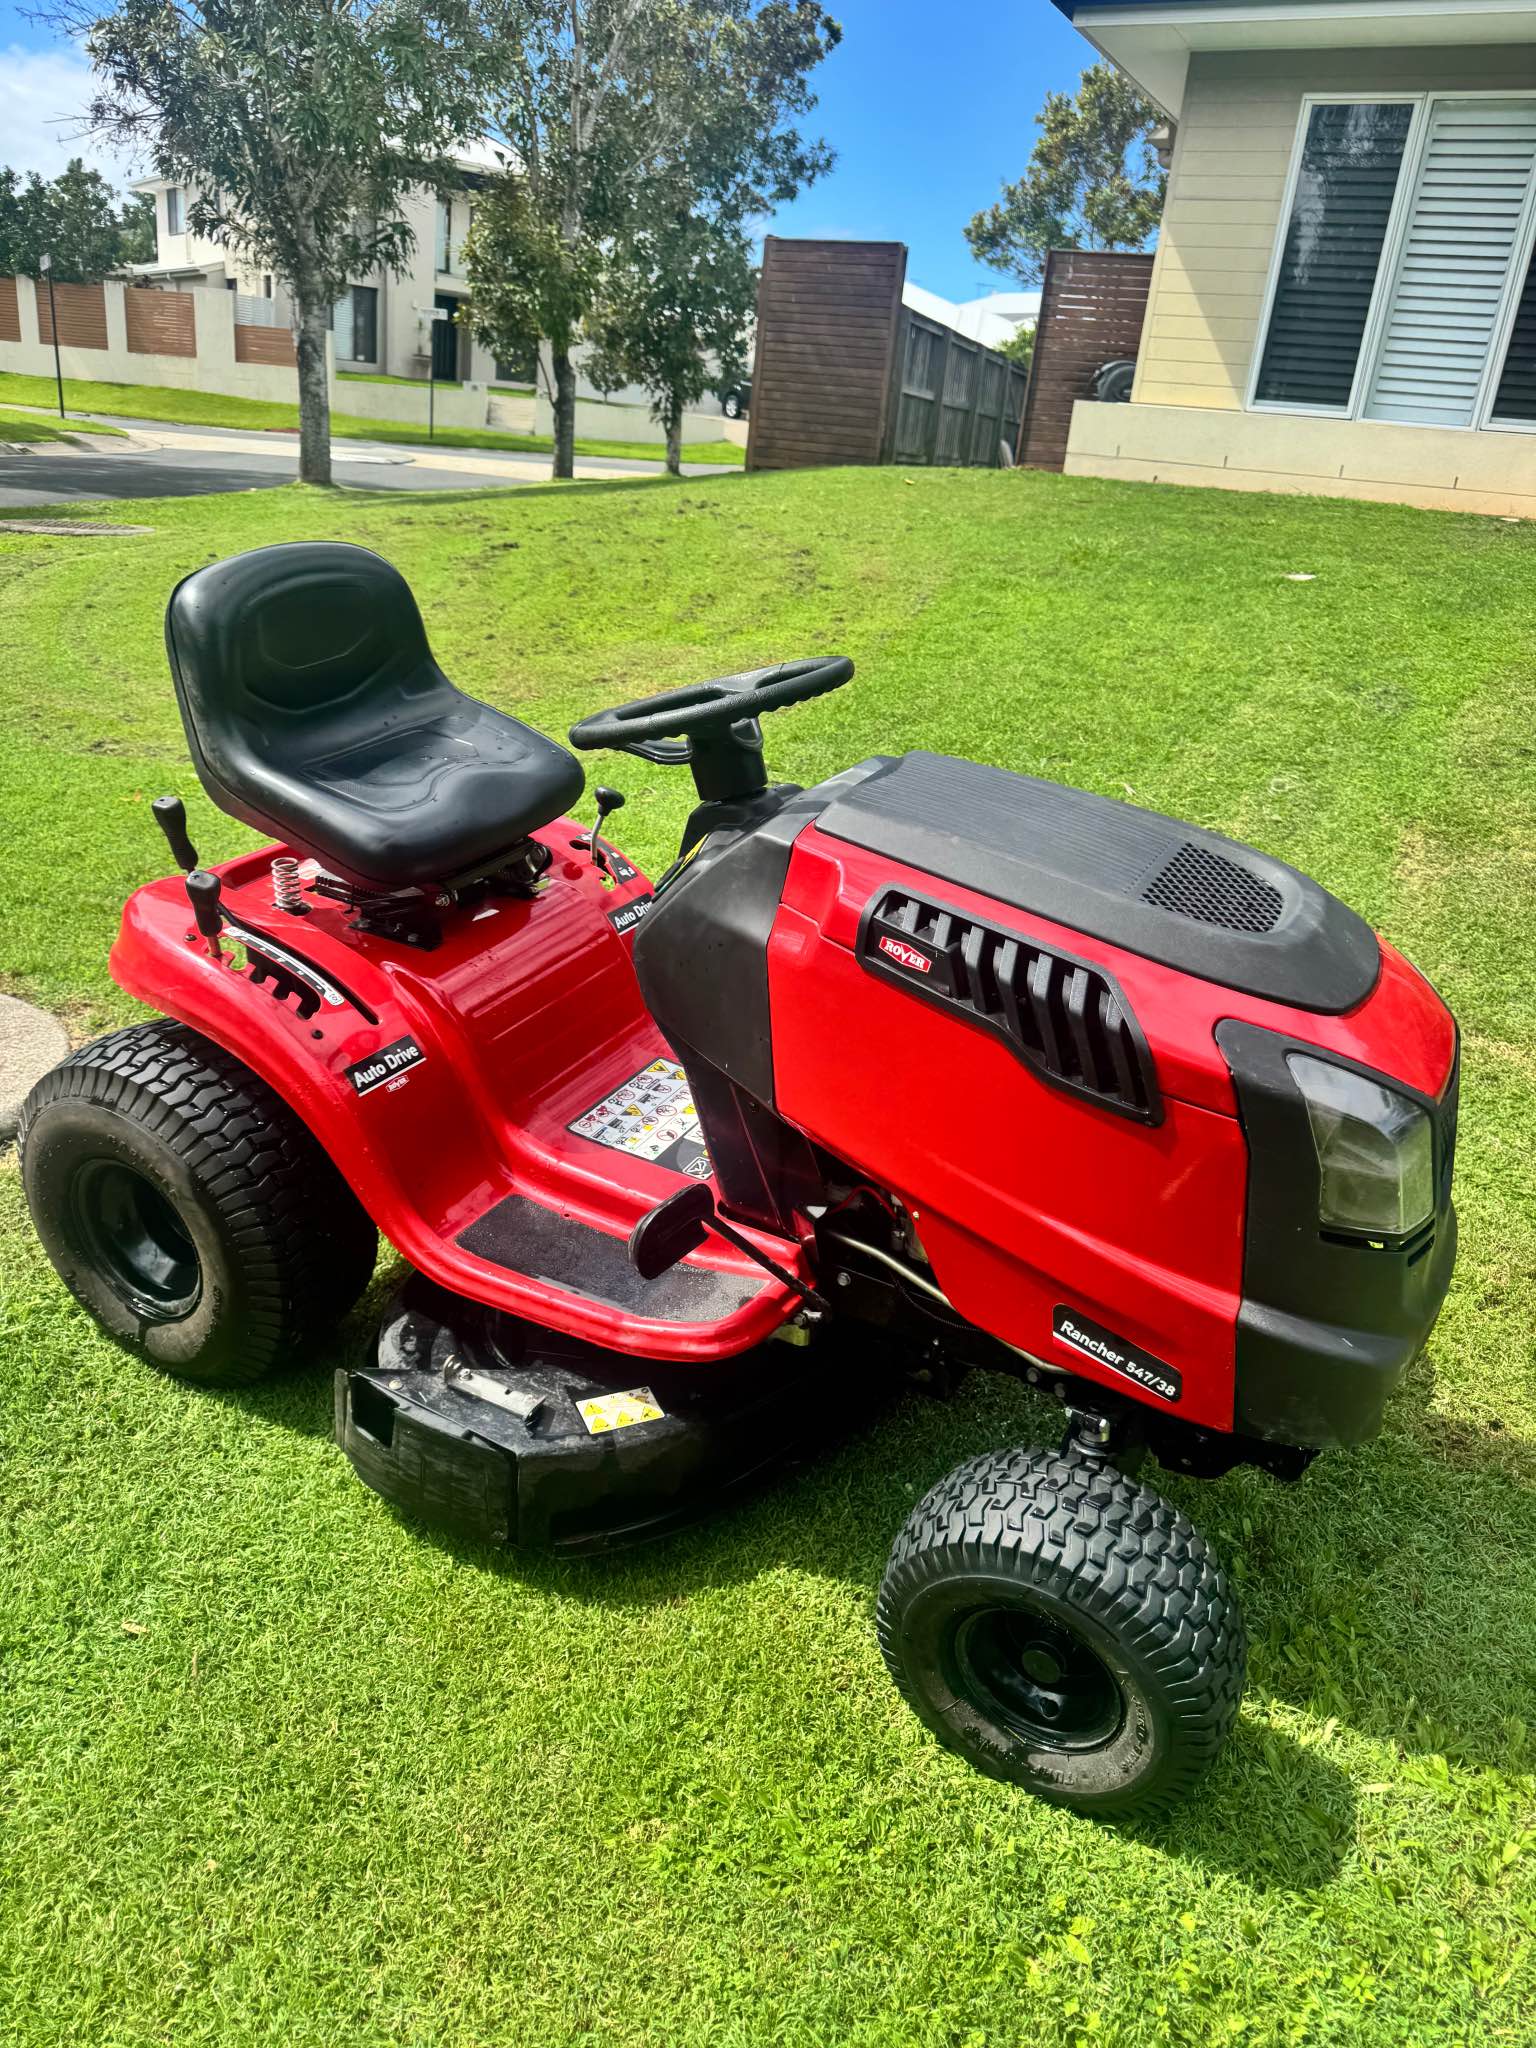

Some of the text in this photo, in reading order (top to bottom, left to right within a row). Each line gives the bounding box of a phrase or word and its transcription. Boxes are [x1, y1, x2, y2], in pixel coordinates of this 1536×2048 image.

[614, 901, 653, 929] Auto Driv
[884, 939, 926, 969] ROVER
[353, 1046, 419, 1089] Auto Drive
[1060, 1320, 1177, 1397] Rancher 547/38
